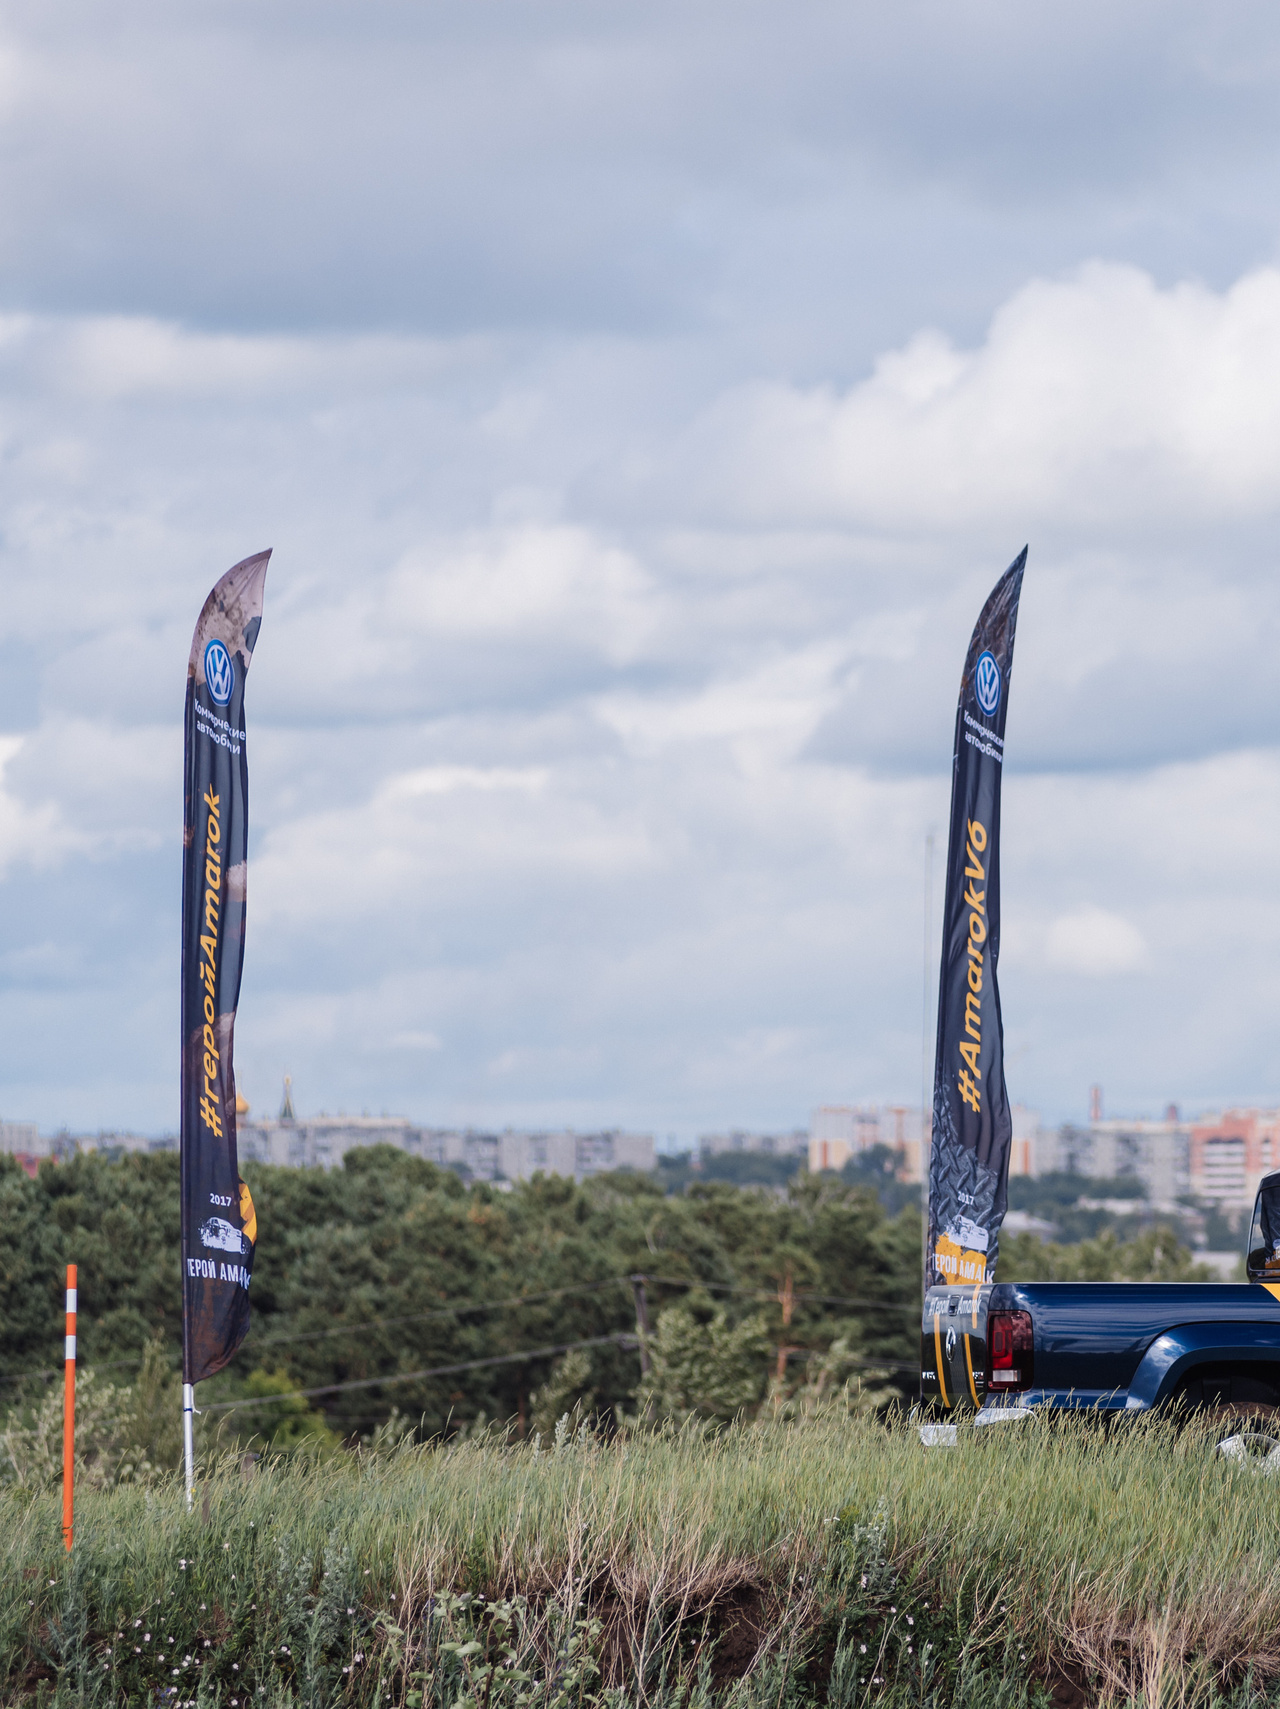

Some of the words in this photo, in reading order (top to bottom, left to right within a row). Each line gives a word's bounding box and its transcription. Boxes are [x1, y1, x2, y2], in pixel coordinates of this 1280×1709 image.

[206, 643, 233, 701] VW
[977, 656, 999, 711] VW
[200, 785, 223, 1137] #геройAmarok
[958, 820, 987, 1112] #AmarokV6
[209, 1193, 232, 1207] 2017
[957, 1190, 974, 1206] 2017
